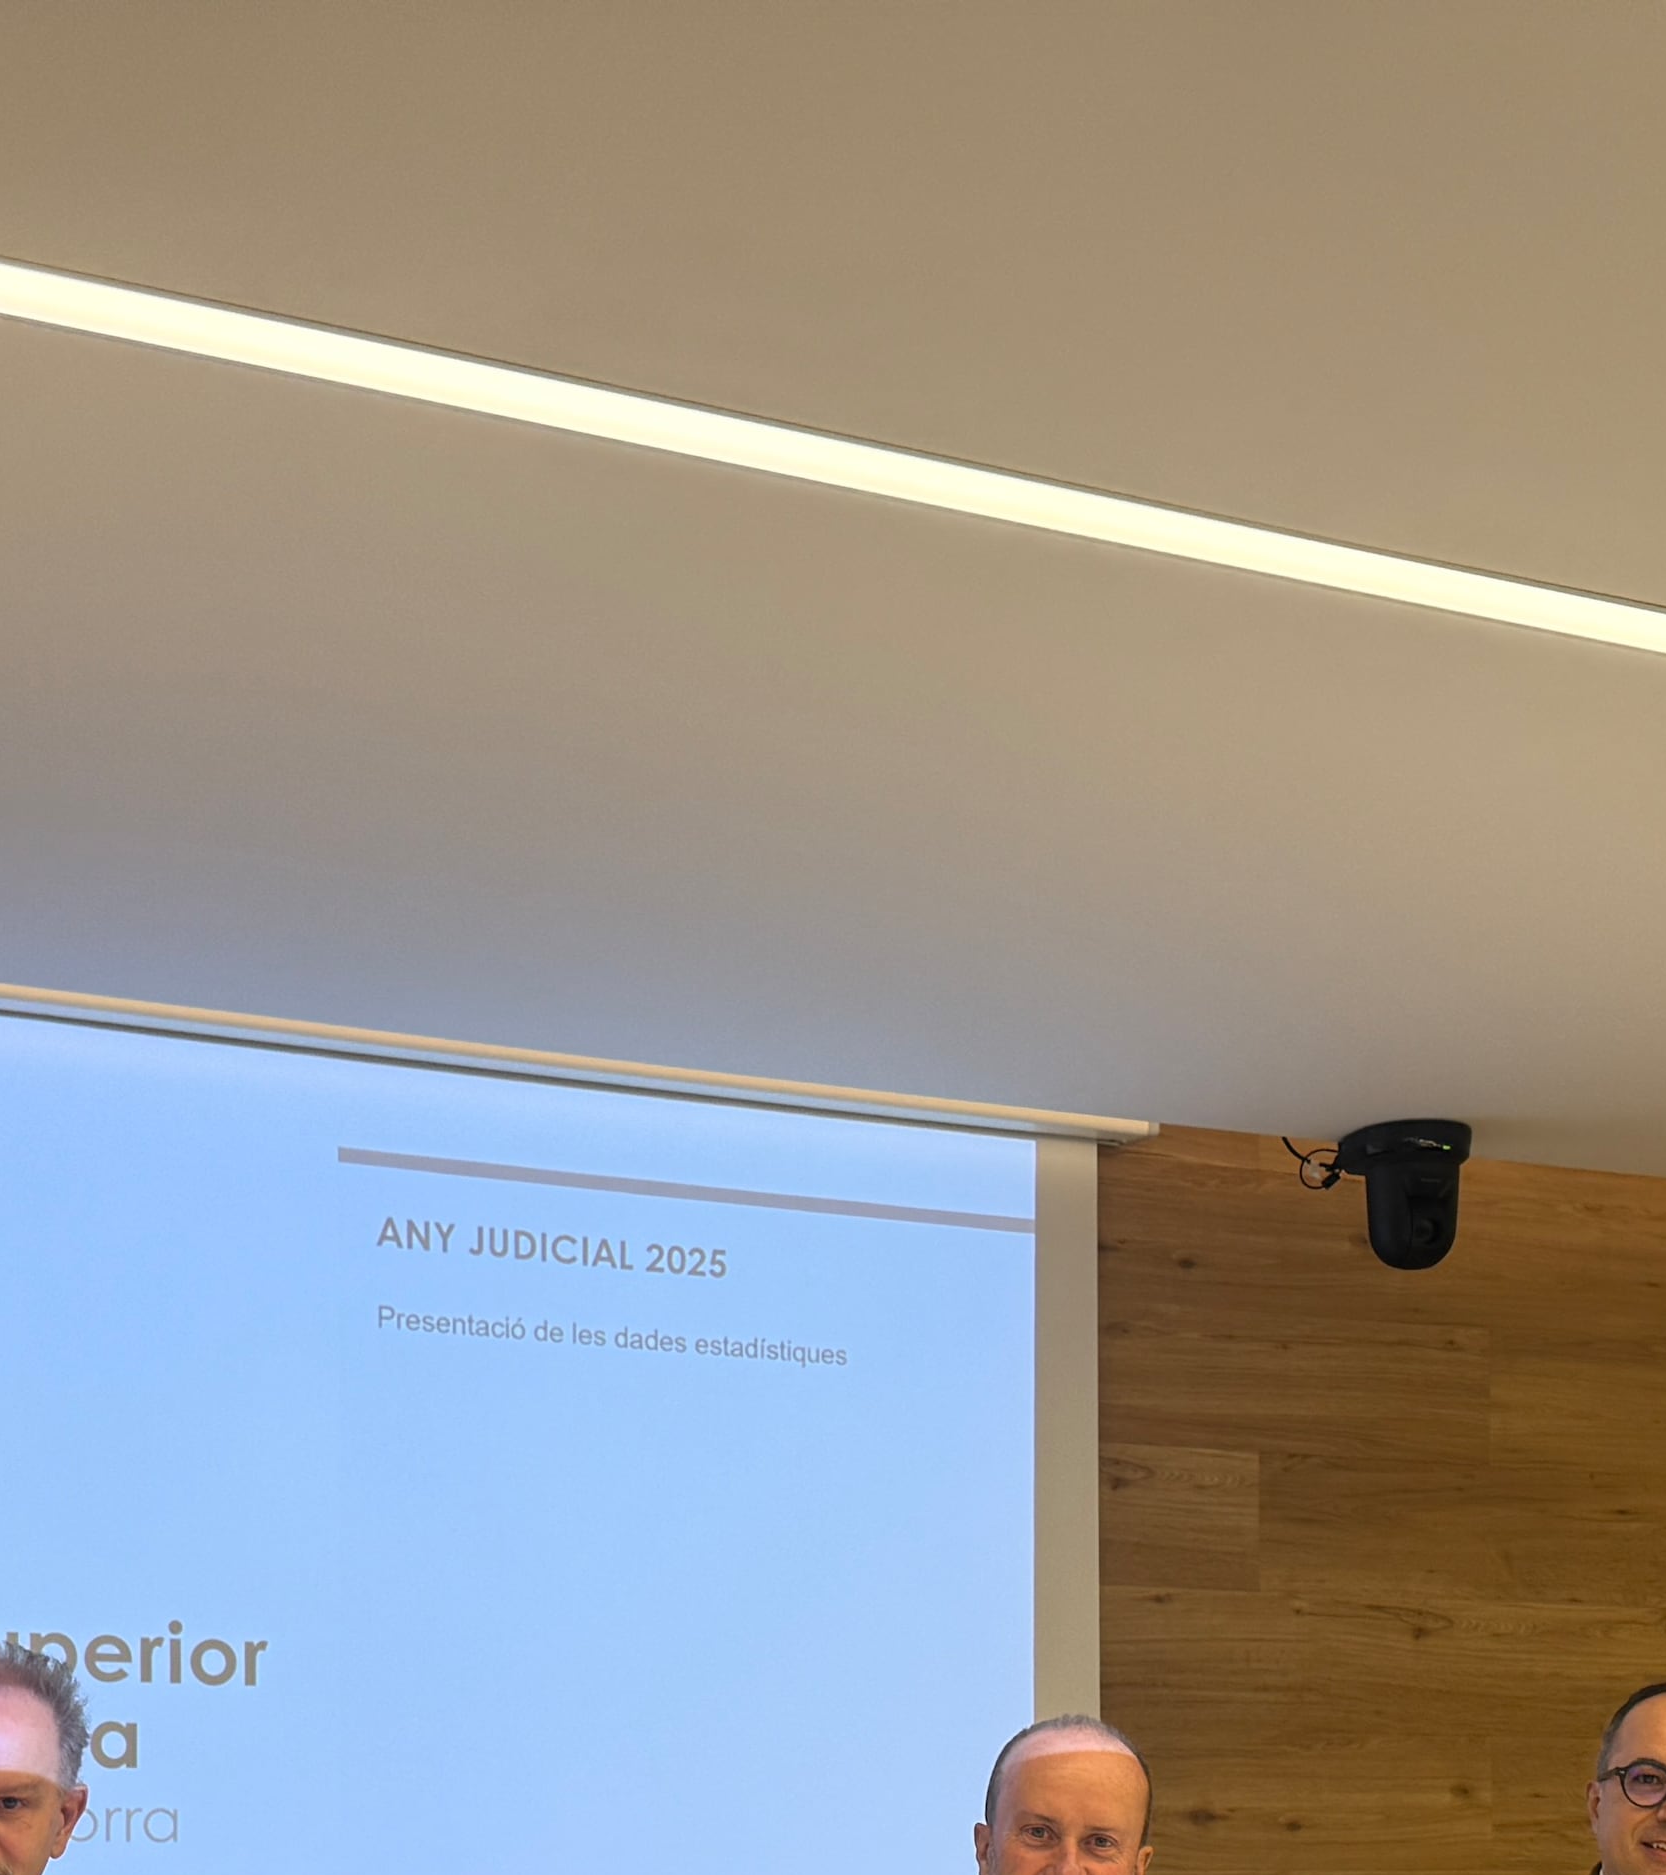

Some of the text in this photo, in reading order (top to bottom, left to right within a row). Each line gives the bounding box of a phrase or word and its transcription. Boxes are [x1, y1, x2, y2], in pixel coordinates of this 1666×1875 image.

[377, 1216, 727, 1279] ANY JUDICIAL 2025
[378, 1305, 848, 1368] Presentació de les dades estadístiques
